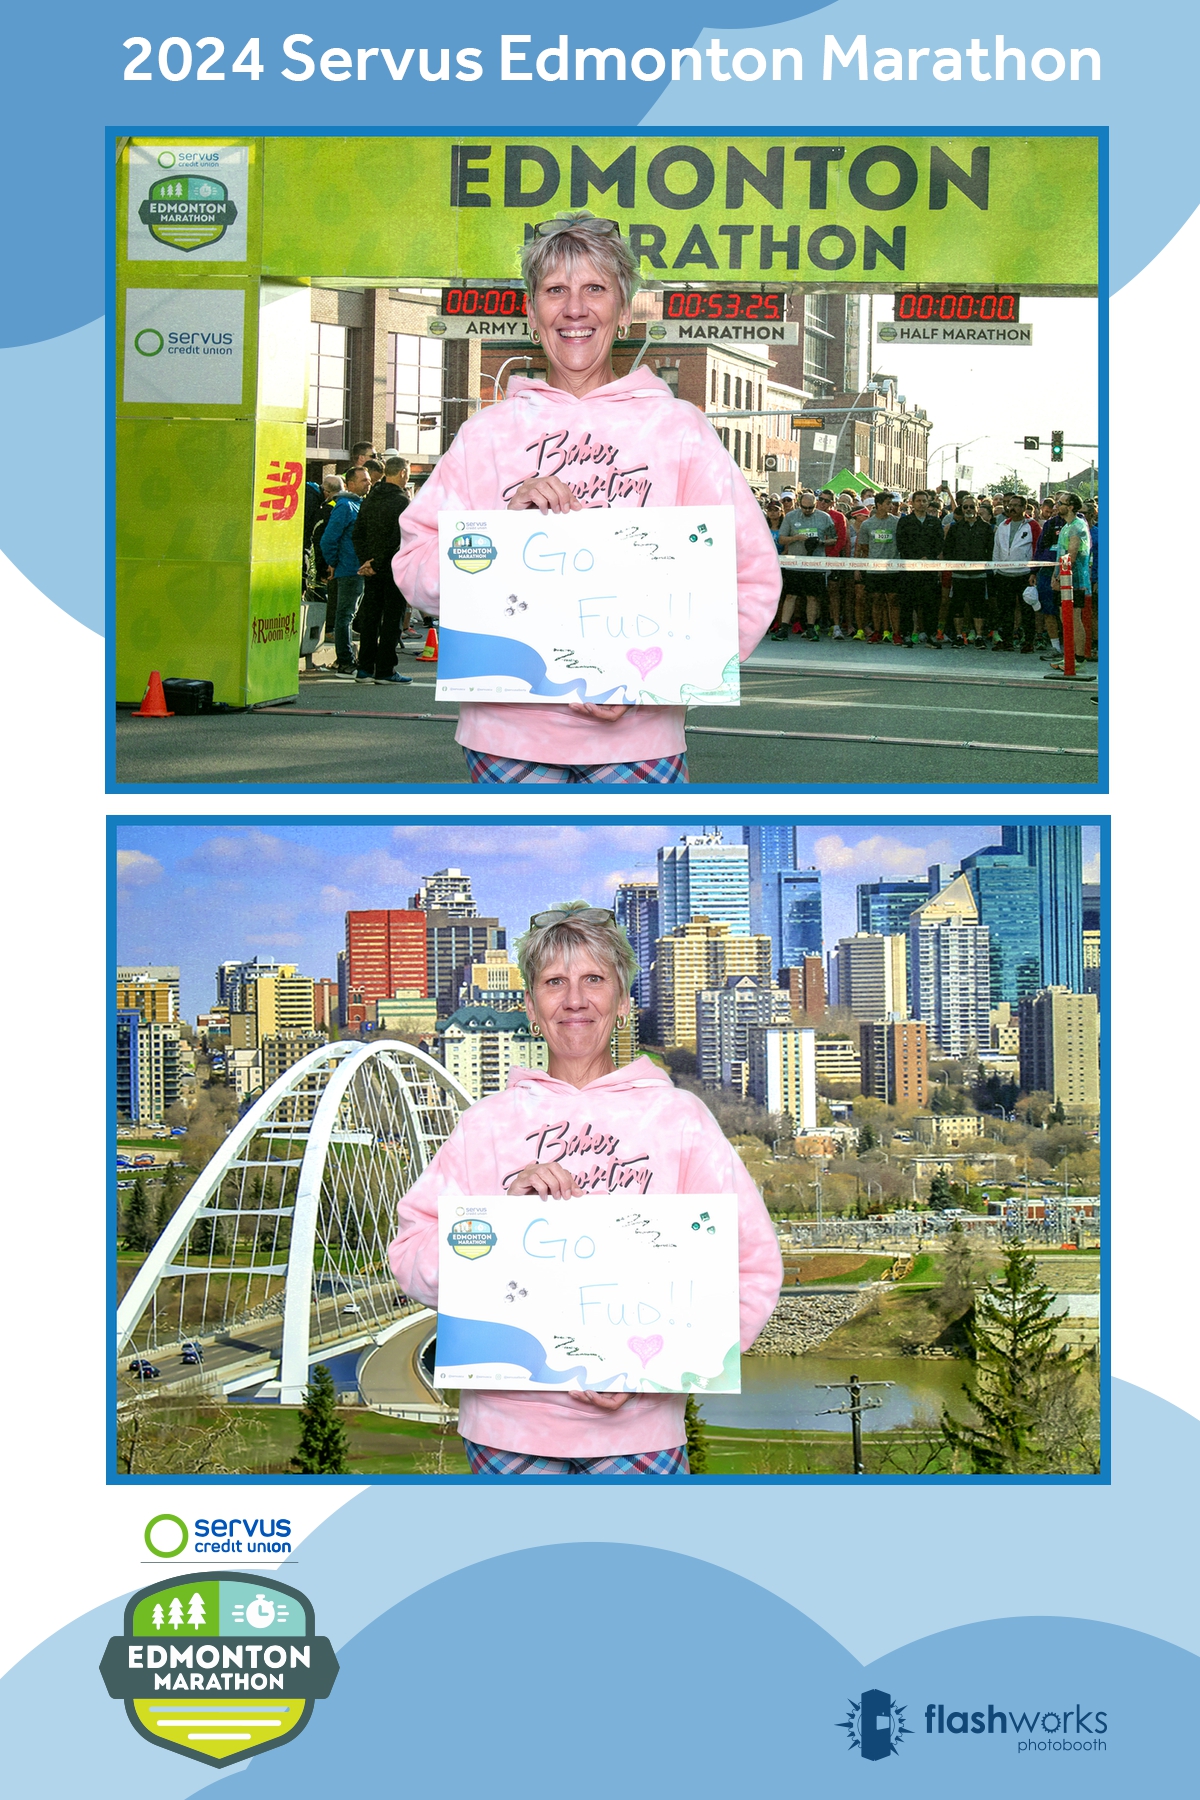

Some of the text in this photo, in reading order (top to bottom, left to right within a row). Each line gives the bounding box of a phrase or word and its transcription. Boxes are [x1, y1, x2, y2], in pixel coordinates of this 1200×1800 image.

[178, 152, 219, 161] servus
[450, 145, 990, 210] EDMONTON
[150, 203, 226, 213] EDMONTON
[160, 214, 215, 222] MARATHON
[524, 223, 906, 271] RATHON
[465, 321, 518, 336] ARMY
[678, 325, 785, 340] MARATHON
[900, 328, 1030, 341] HALF MARATHON
[168, 332, 233, 345] servus
[167, 345, 233, 355] credit union
[257, 613, 290, 643] Running
